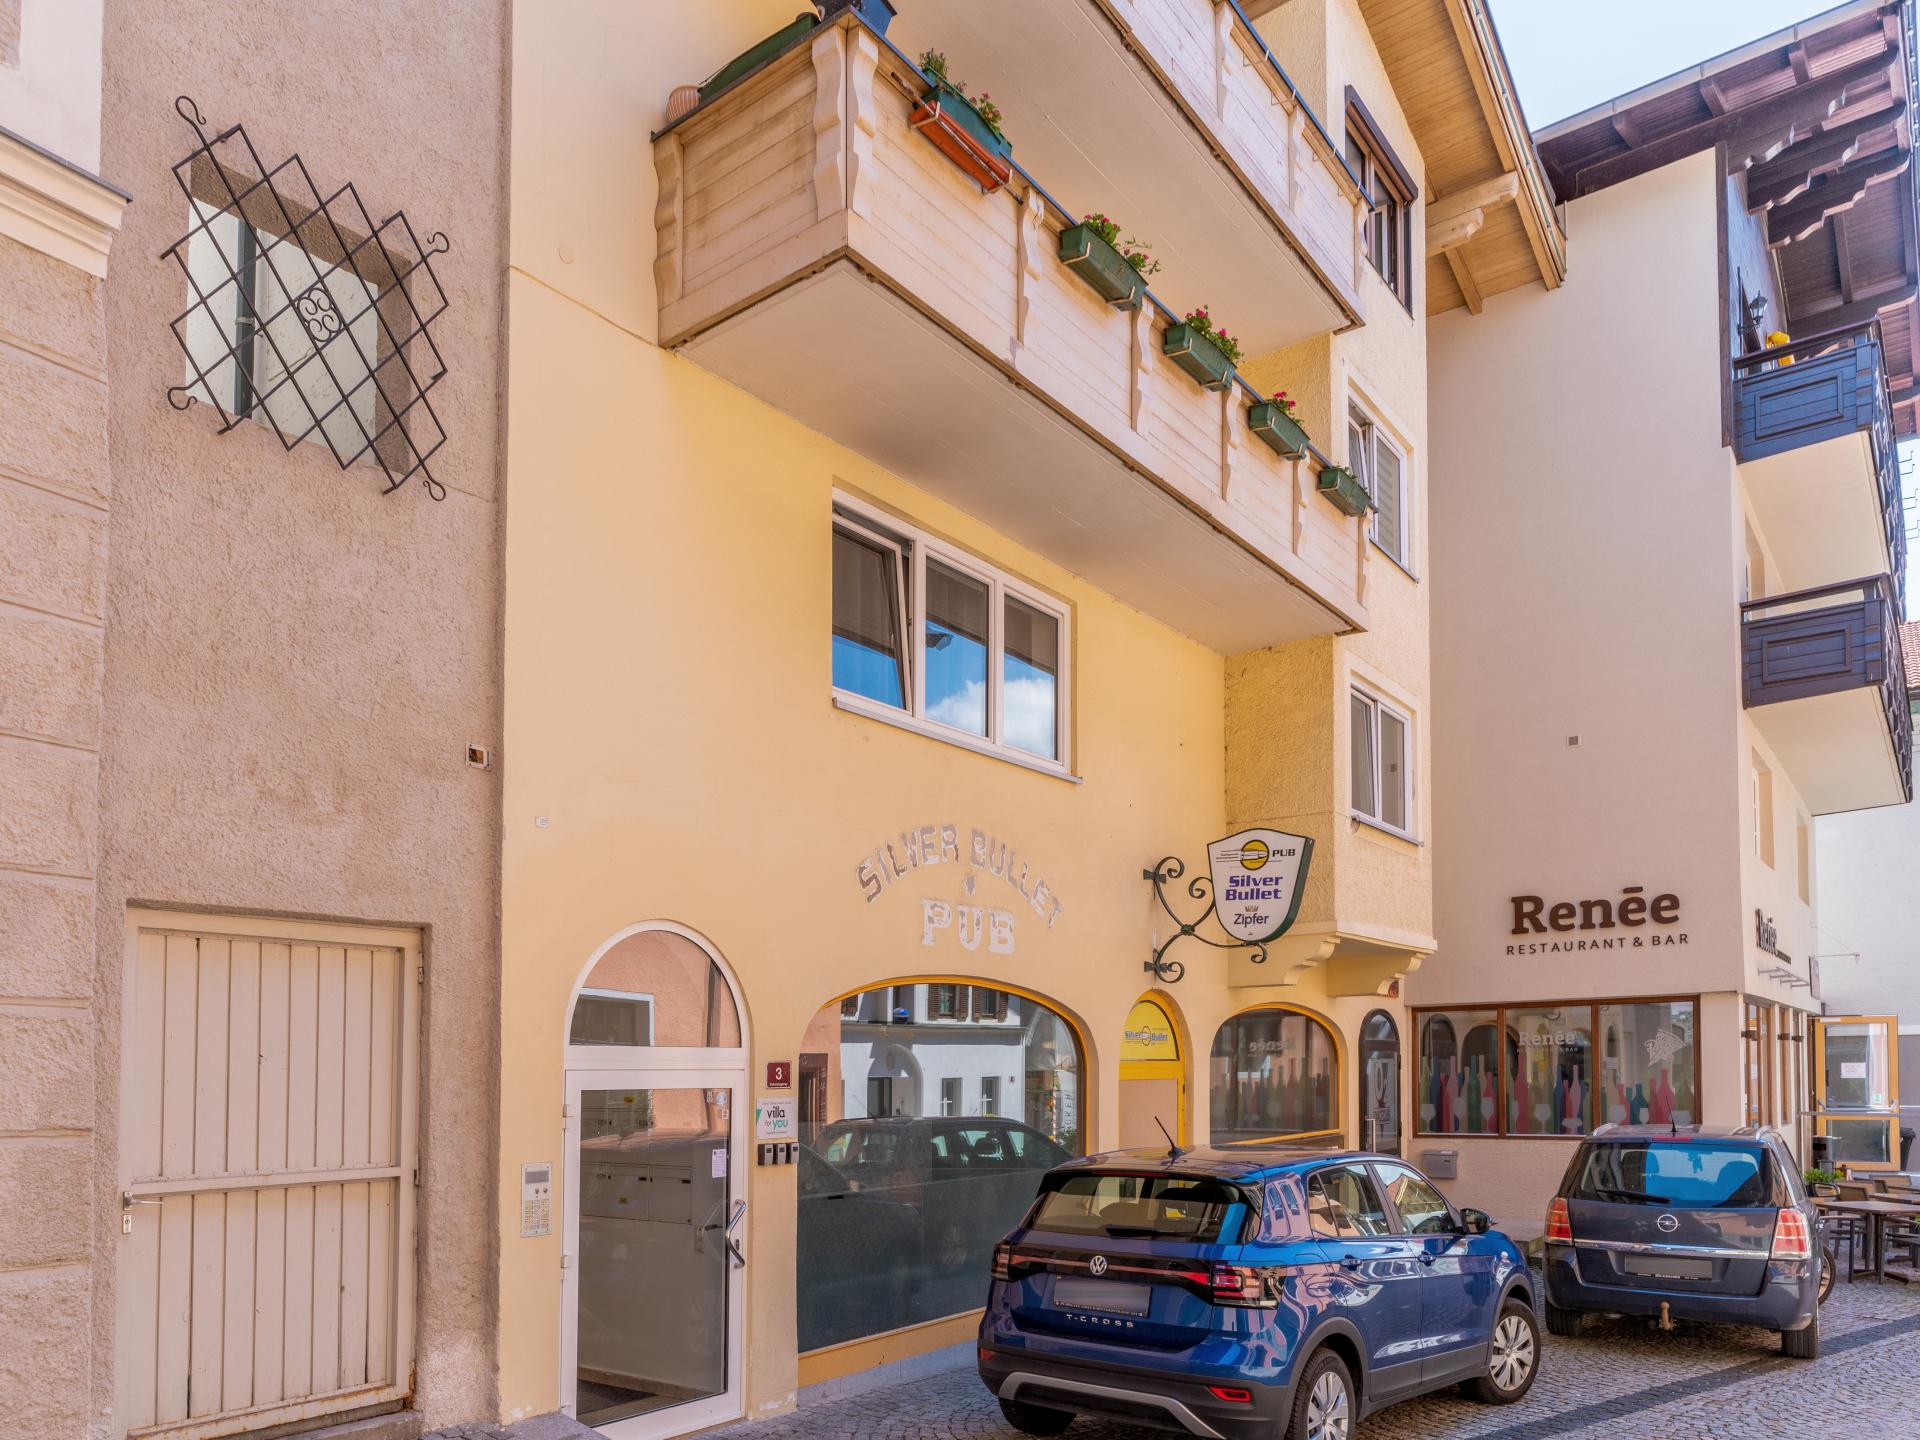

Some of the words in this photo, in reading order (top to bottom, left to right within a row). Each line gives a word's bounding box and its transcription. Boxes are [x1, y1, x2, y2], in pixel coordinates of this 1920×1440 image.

[1272, 849, 1296, 857] PUB
[856, 824, 959, 903] SILVER
[969, 828, 1063, 929] BULLET
[1229, 875, 1283, 888] Silver
[1225, 888, 1282, 901] Bullet
[921, 897, 1016, 955] PUB
[1233, 913, 1270, 928] Zipfer
[1506, 937, 1627, 956] RESTAURANT
[1632, 936, 1644, 947] &
[1652, 933, 1689, 946] BAR
[775, 1067, 783, 1080] 3
[767, 1105, 786, 1118] villa
[772, 1119, 788, 1130] you
[1066, 1313, 1134, 1328] T-CROSS
